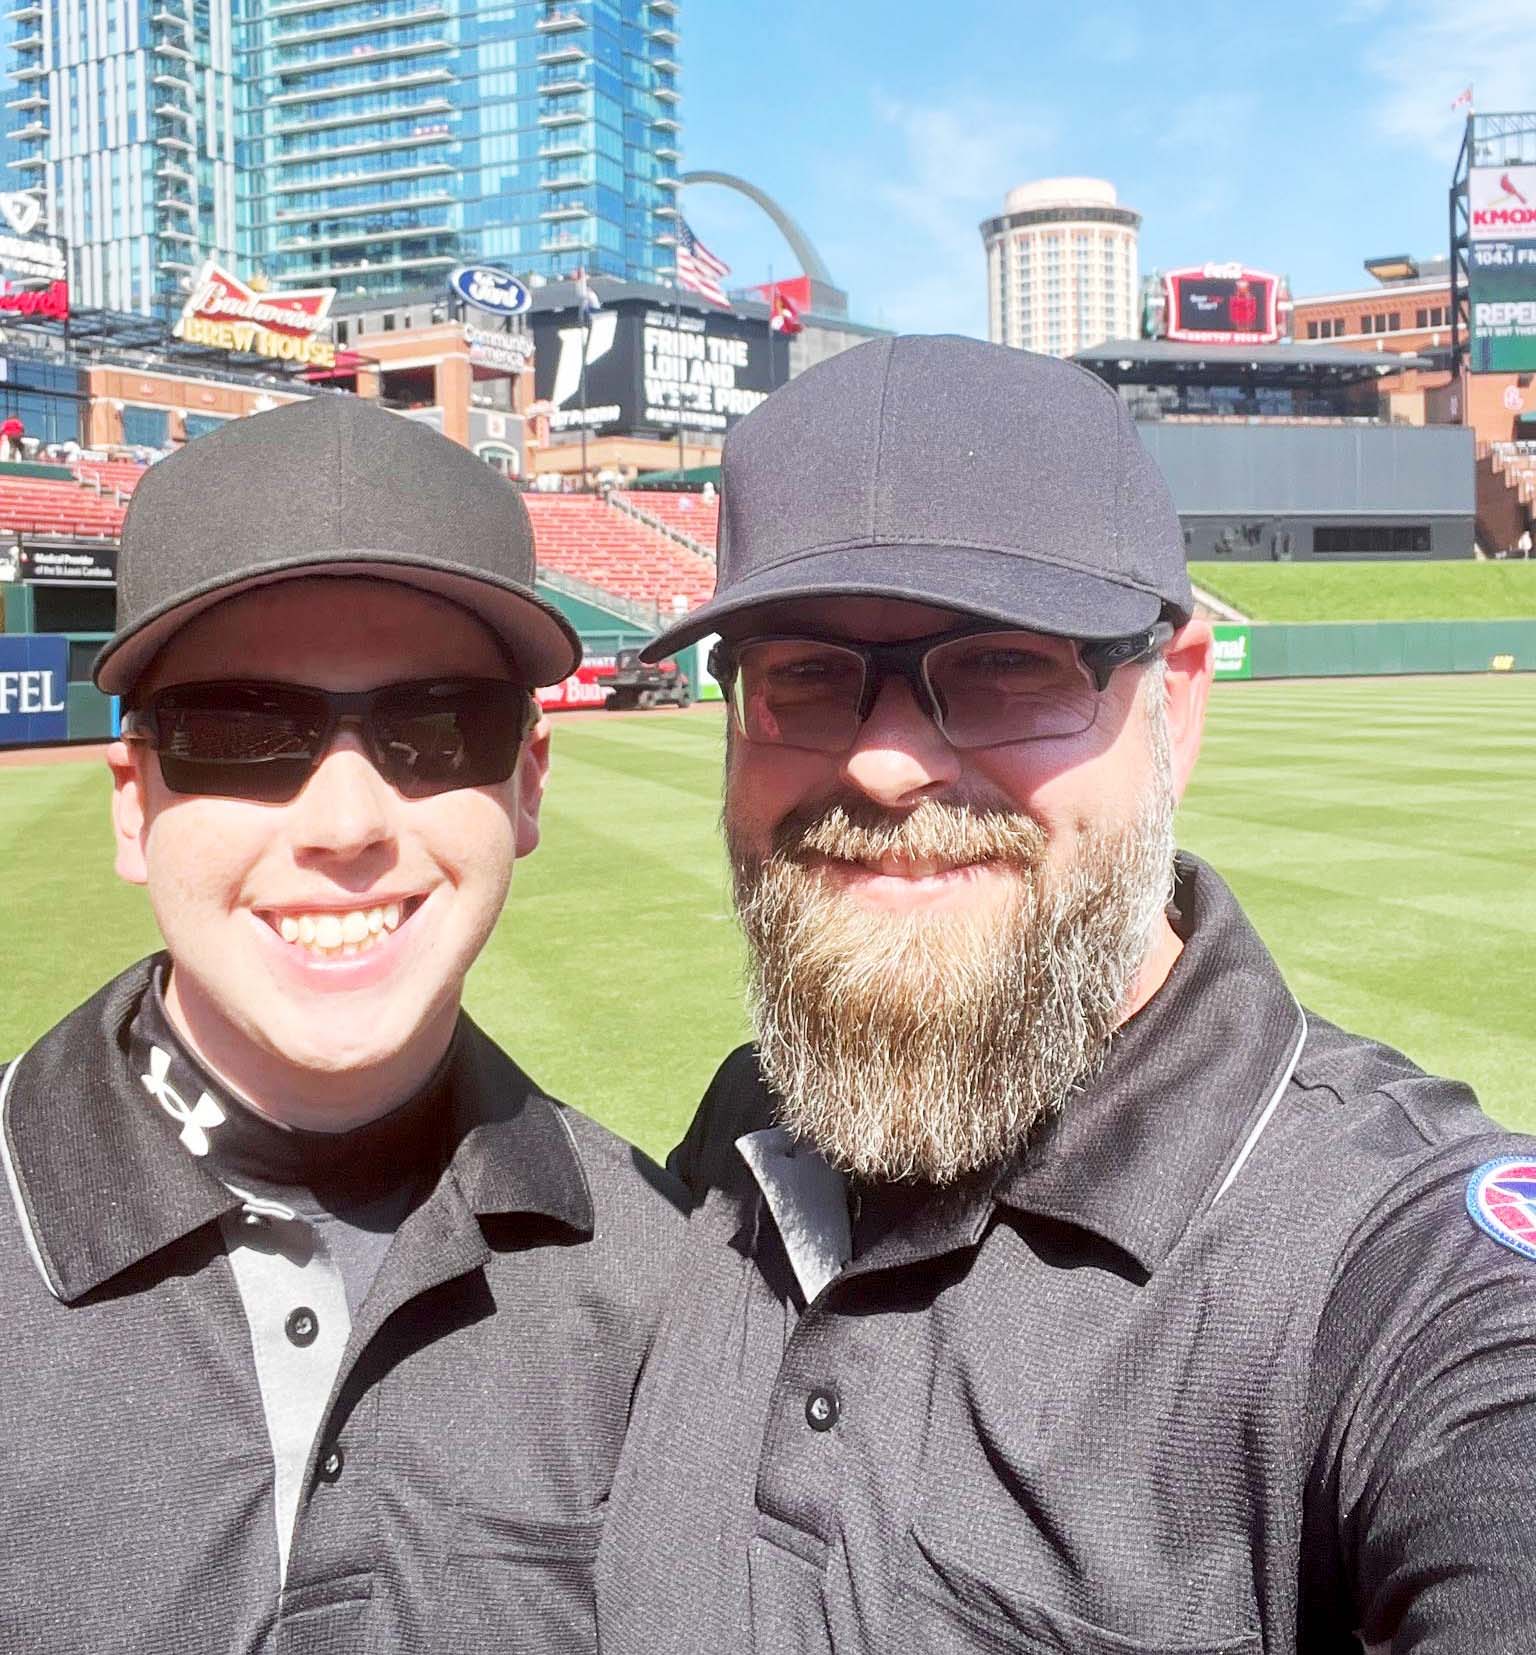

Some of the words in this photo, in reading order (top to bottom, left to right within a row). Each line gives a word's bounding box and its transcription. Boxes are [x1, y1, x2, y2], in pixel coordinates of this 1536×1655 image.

[1475, 249, 1514, 265] 104.1
[194, 282, 332, 332] Budweiser
[469, 271, 519, 307] Ford
[184, 315, 255, 353] BREW
[256, 332, 336, 368] HOUSE
[706, 336, 749, 368] THE
[689, 358, 735, 389] AND
[0, 670, 65, 714] FEL
